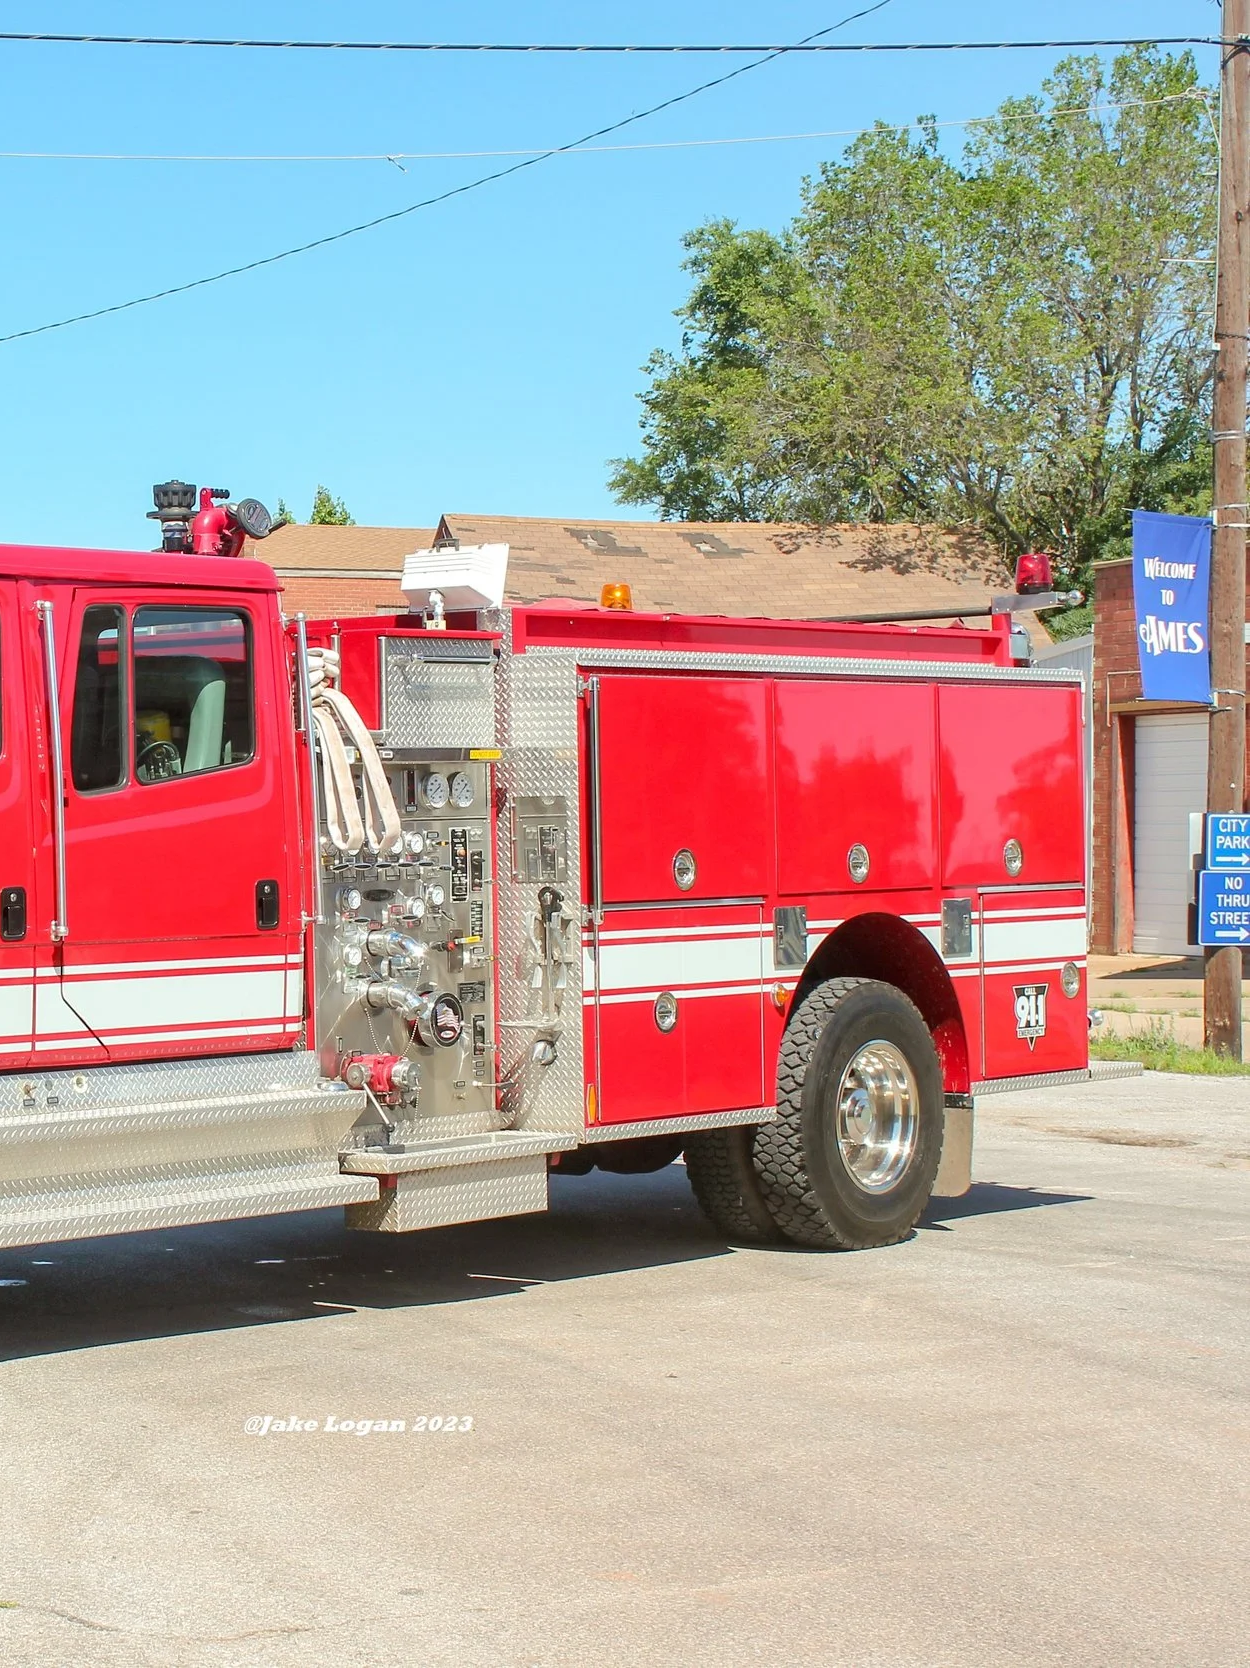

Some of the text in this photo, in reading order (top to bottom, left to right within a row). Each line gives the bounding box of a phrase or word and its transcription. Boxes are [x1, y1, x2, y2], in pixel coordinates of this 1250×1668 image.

[1160, 589, 1175, 606] TO
[1139, 615, 1204, 656] AMES
[1218, 818, 1248, 833] CITY
[1215, 835, 1250, 849] PARK
[1224, 876, 1243, 890] NO
[1216, 894, 1250, 908] THRU
